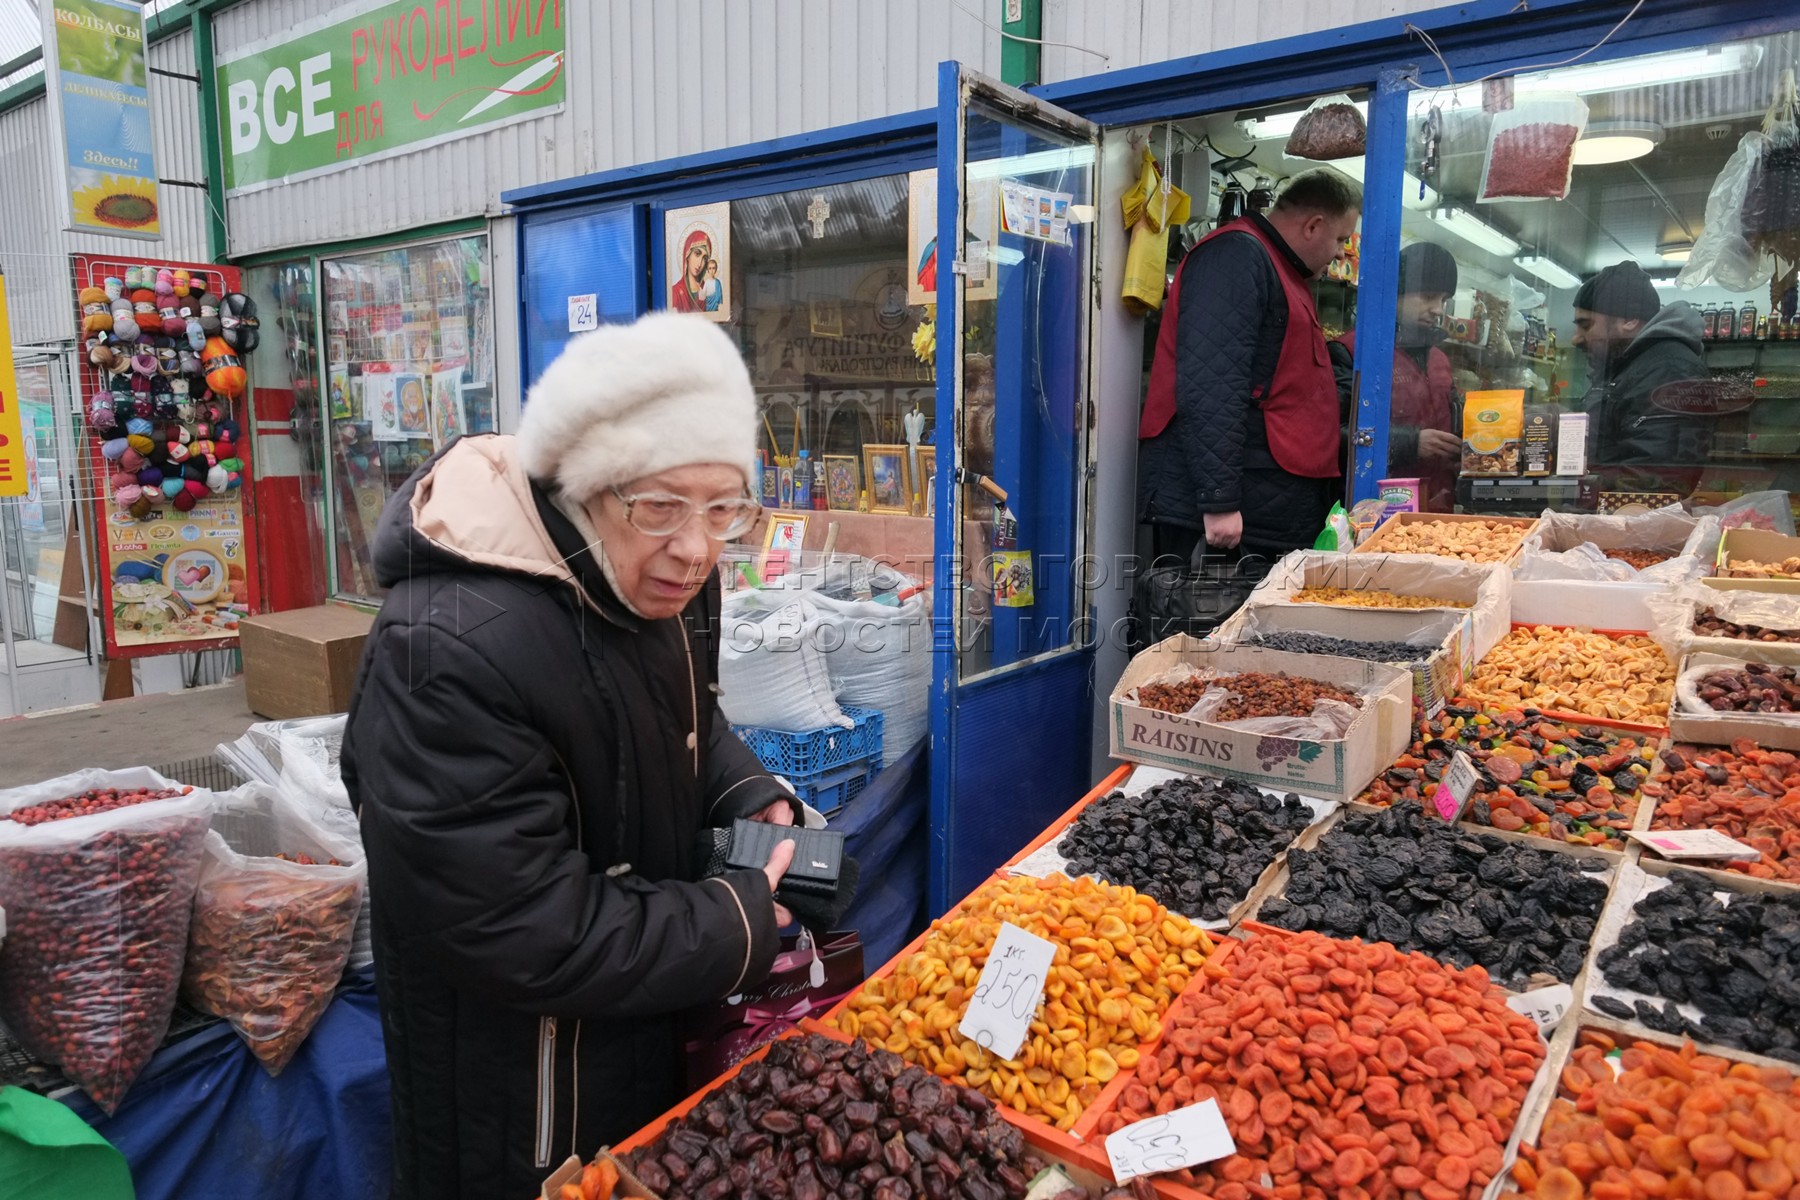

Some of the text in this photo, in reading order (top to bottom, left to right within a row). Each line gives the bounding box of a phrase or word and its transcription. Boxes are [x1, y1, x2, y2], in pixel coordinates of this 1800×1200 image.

[55, 8, 141, 40] КОЛБАСЫ
[64, 82, 148, 106] ДЕЛИКАТЕСЫ
[228, 51, 335, 156] ВСЕ
[336, 99, 384, 158] ДЛЯ
[83, 150, 138, 169] Здесь!!
[577, 303, 592, 325] 24
[1131, 723, 1233, 761] RAISINS
